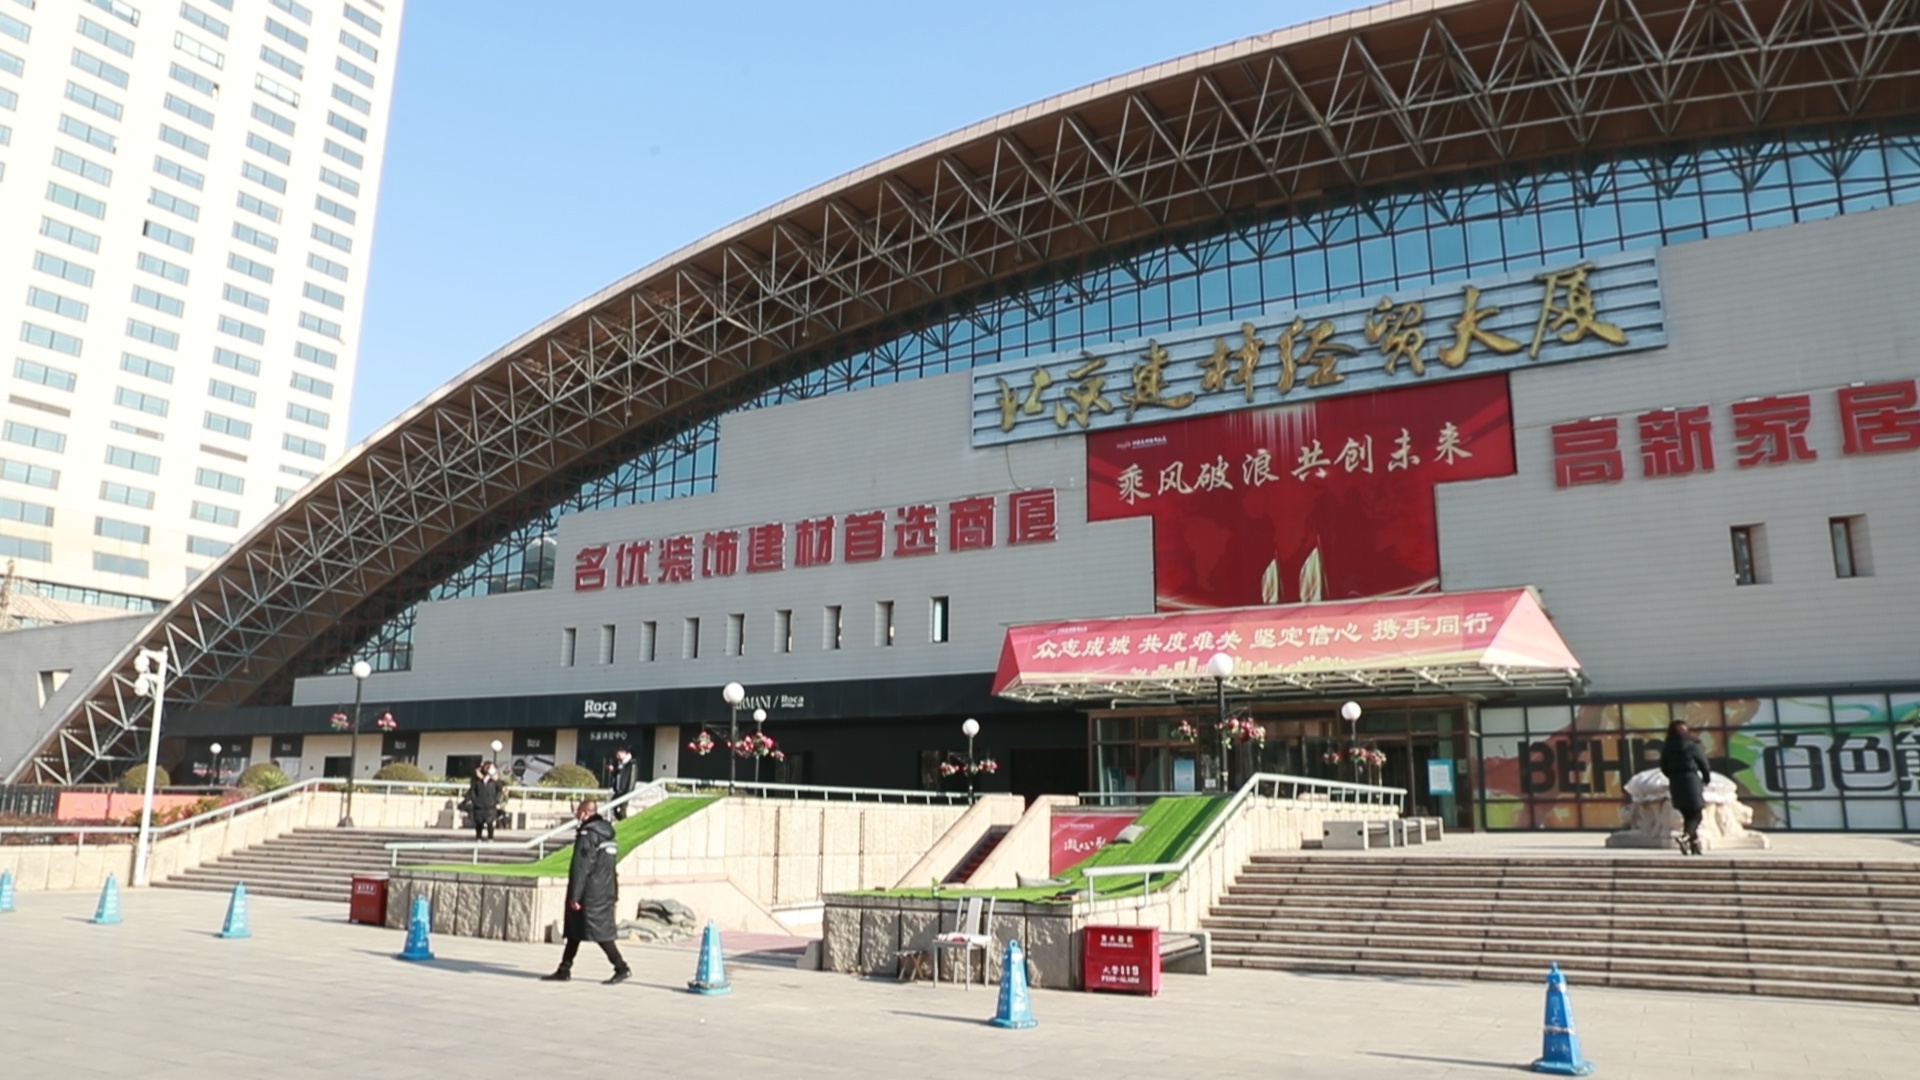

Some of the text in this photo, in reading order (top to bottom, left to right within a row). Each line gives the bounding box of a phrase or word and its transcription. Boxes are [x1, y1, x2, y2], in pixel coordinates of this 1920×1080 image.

[1117, 421, 1473, 506] 乘风破浪共创未来
[1551, 379, 1920, 488] 高新家居
[575, 487, 1058, 592] 名优装饰建材首选商厦
[1032, 612, 1494, 660] 众志成城 共度难关 坚定信心 携手同行
[585, 699, 617, 716] Roca
[736, 695, 771, 710] RMANI
[781, 695, 804, 706] Roca
